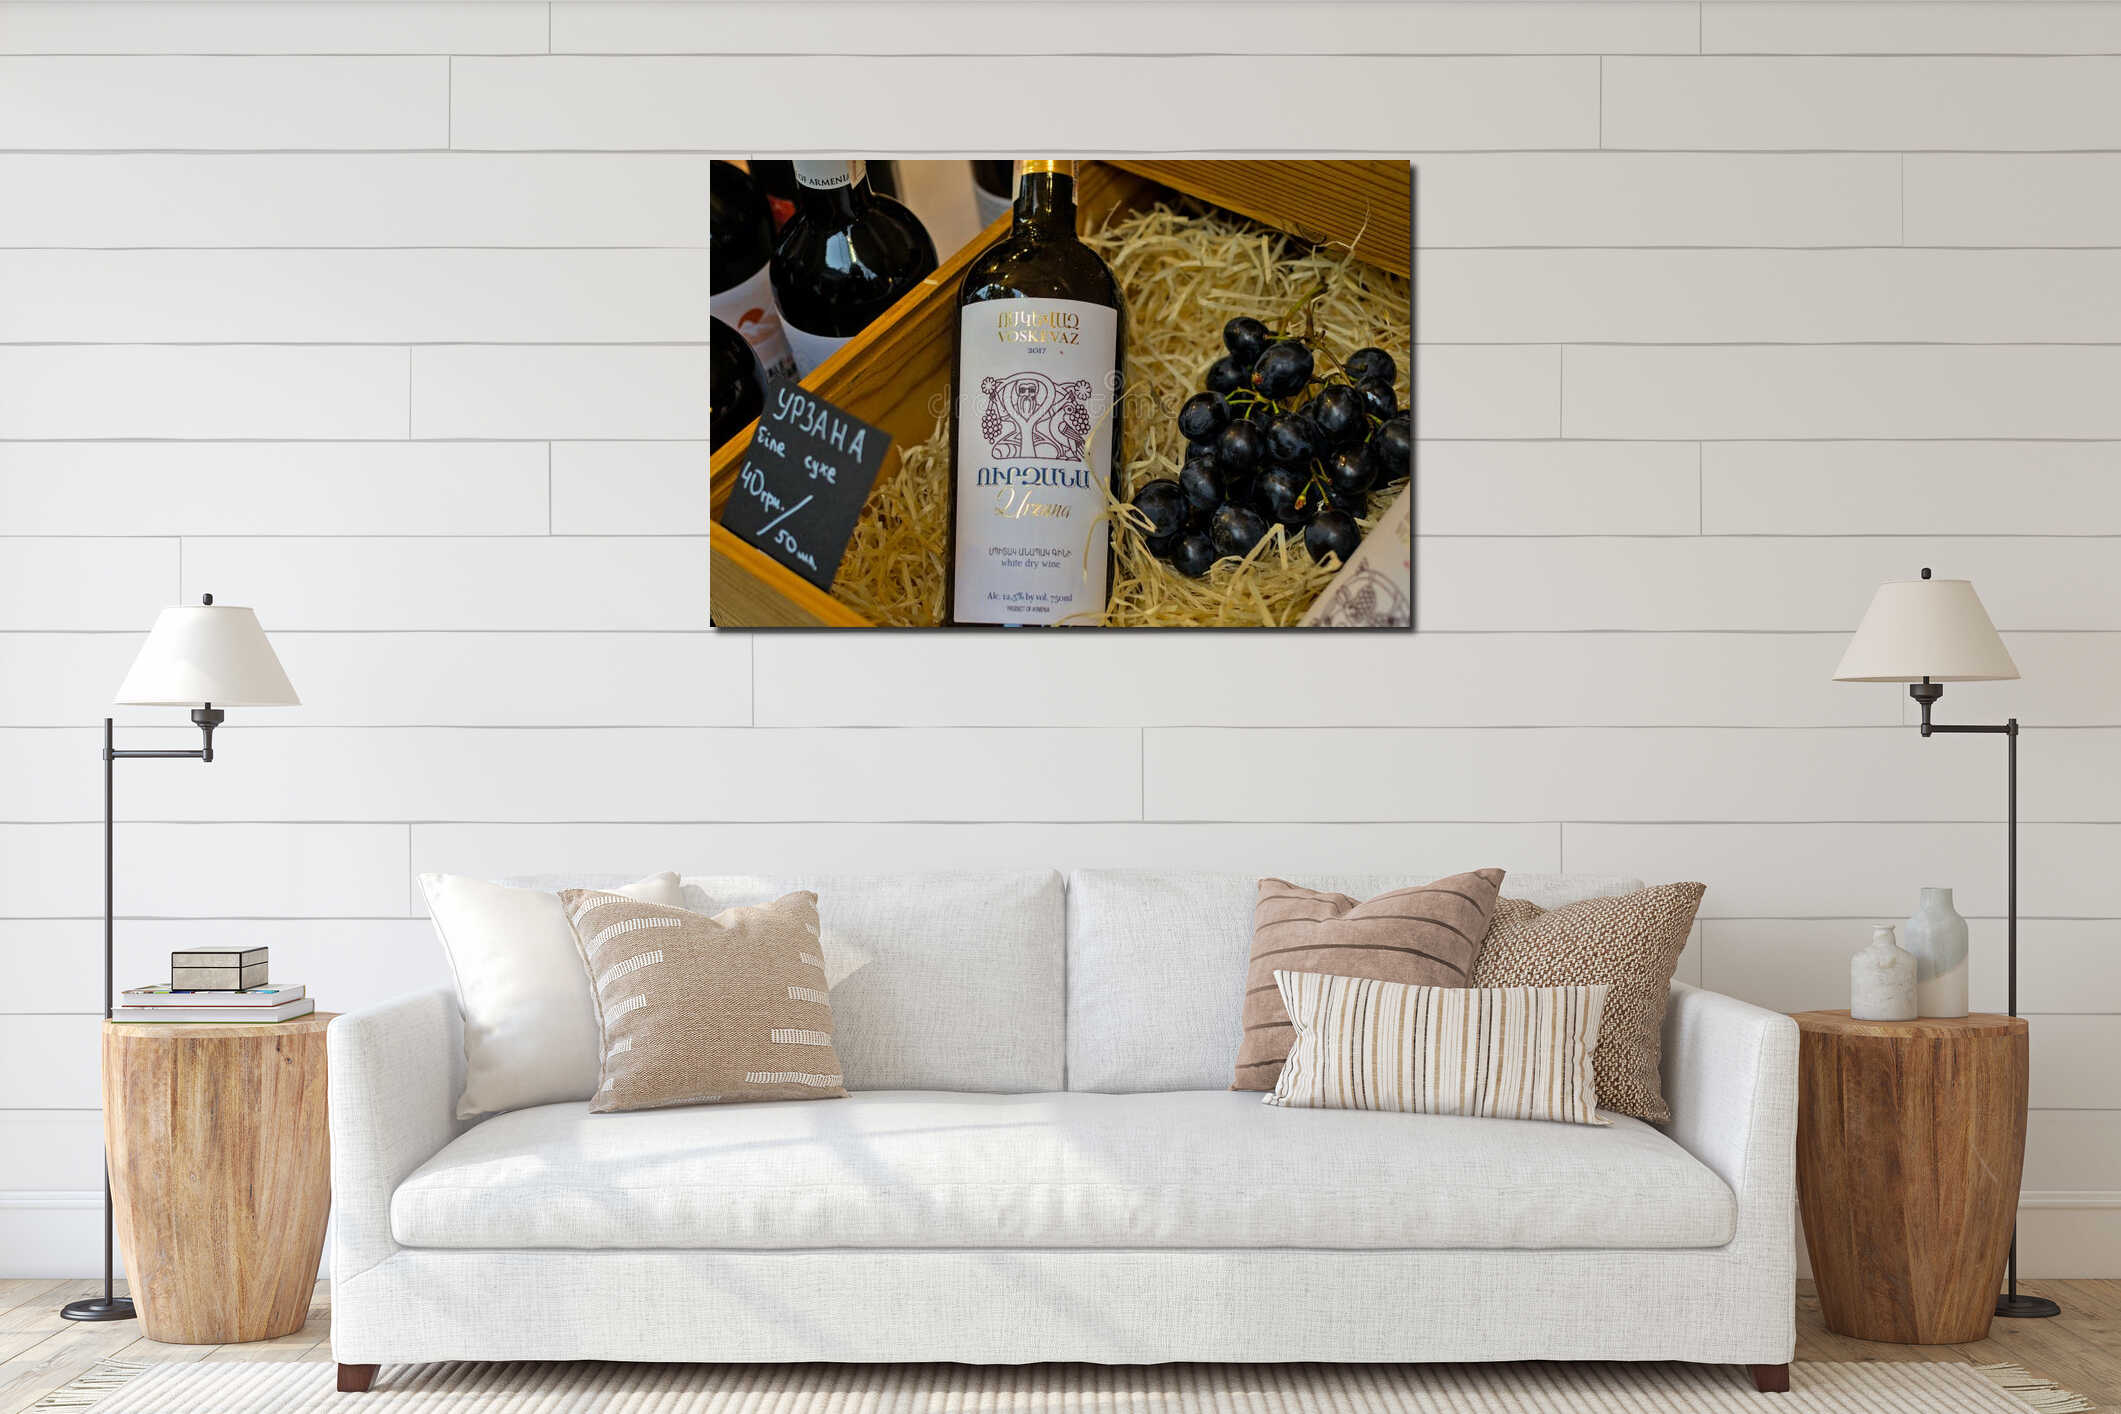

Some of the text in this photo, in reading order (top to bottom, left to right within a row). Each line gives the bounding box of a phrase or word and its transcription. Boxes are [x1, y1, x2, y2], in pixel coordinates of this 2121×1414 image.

[997, 330, 1080, 344] VOSKEVAZ
[773, 387, 867, 464] УРЗАНА
[1001, 559, 1062, 570] white dry wine
